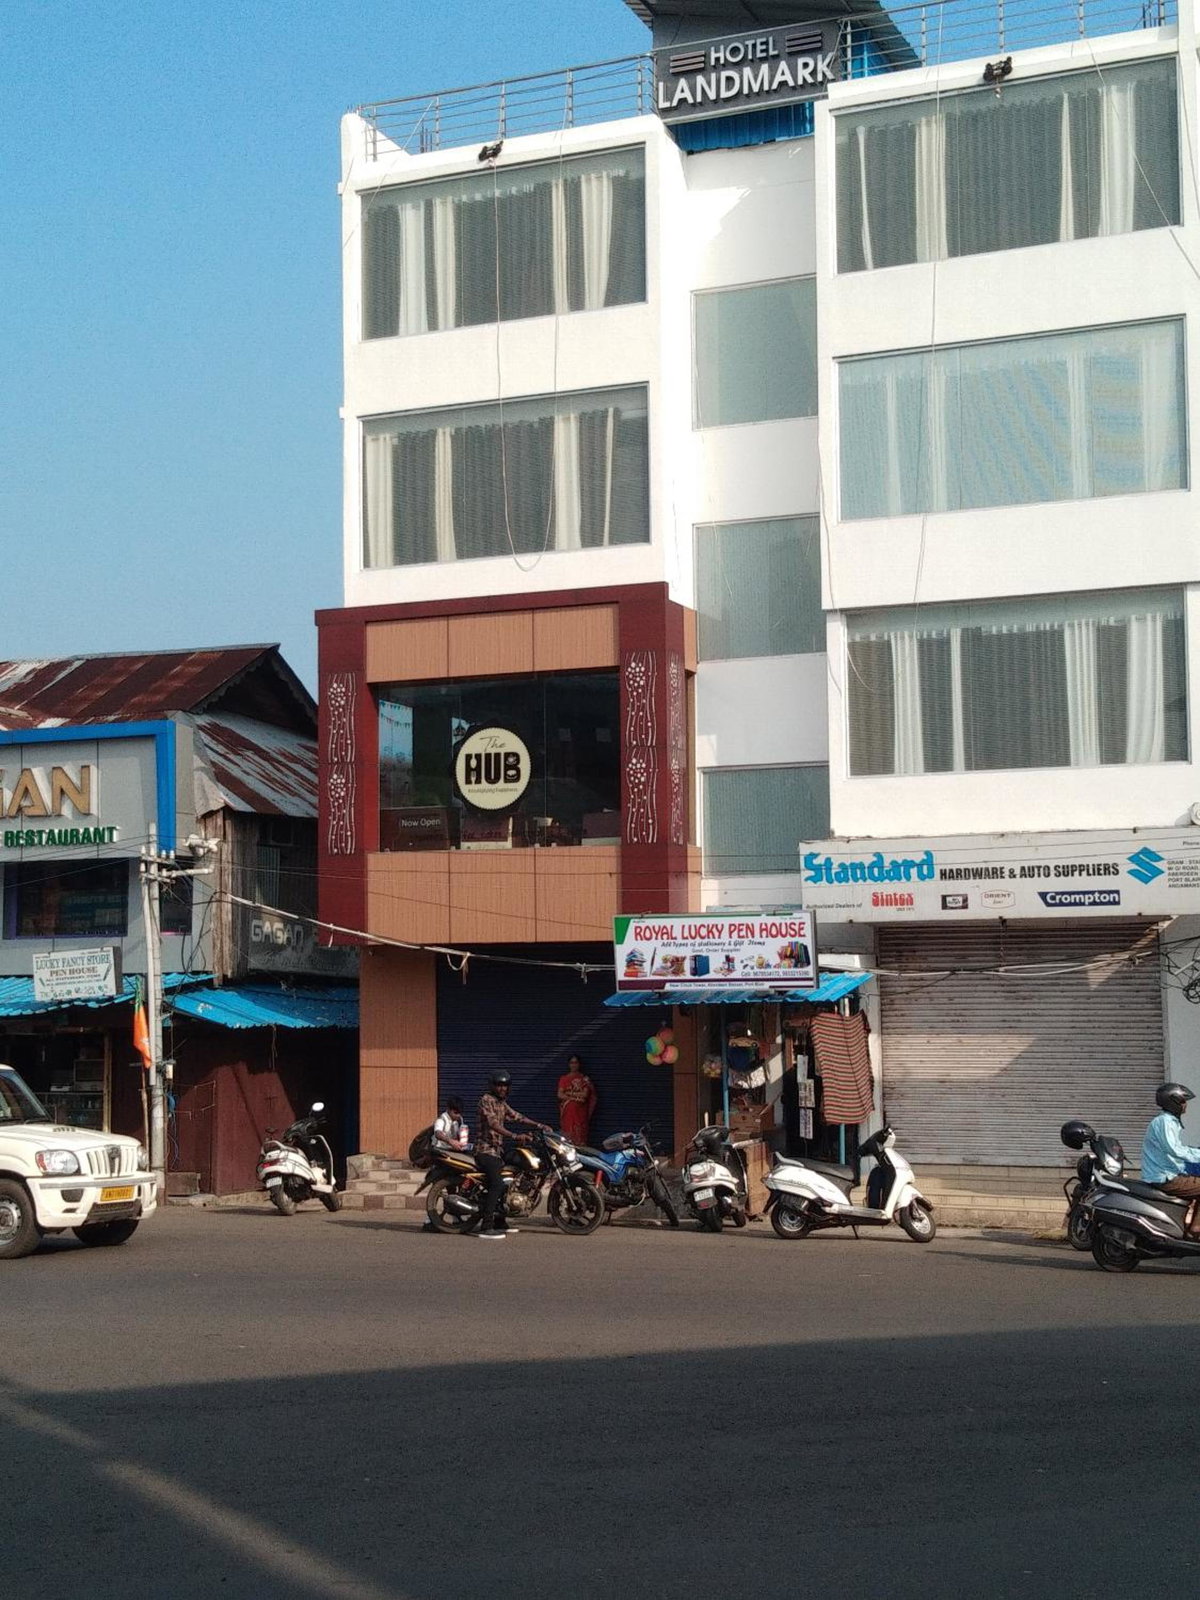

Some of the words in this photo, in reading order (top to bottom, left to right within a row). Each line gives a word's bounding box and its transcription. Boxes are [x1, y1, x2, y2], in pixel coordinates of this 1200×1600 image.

[710, 36, 778, 66] HOTEL
[658, 52, 836, 109] LANDMARK
[480, 735, 506, 752] The
[465, 752, 521, 785] HUB
[401, 819, 418, 827] Now
[420, 818, 440, 828] Open
[4, 826, 117, 848] RESTAURANT
[803, 850, 935, 884] Standard
[940, 867, 1007, 881] HARDWARE
[1009, 868, 1017, 878] &
[1019, 865, 1051, 878] AUTO
[1053, 863, 1120, 877] SUPPLIERS
[871, 891, 914, 907] Sintex
[1046, 892, 1119, 906] Crompton
[634, 924, 677, 941] ROYAL
[681, 923, 724, 940] LUCKY
[728, 922, 755, 939] PEN
[759, 921, 807, 938] HOUSE
[36, 958, 59, 970] LUCKY
[62, 955, 86, 968] FANCY
[87, 953, 111, 965] STORE
[50, 969, 66, 977] PEN
[69, 966, 98, 975] HOUSE
